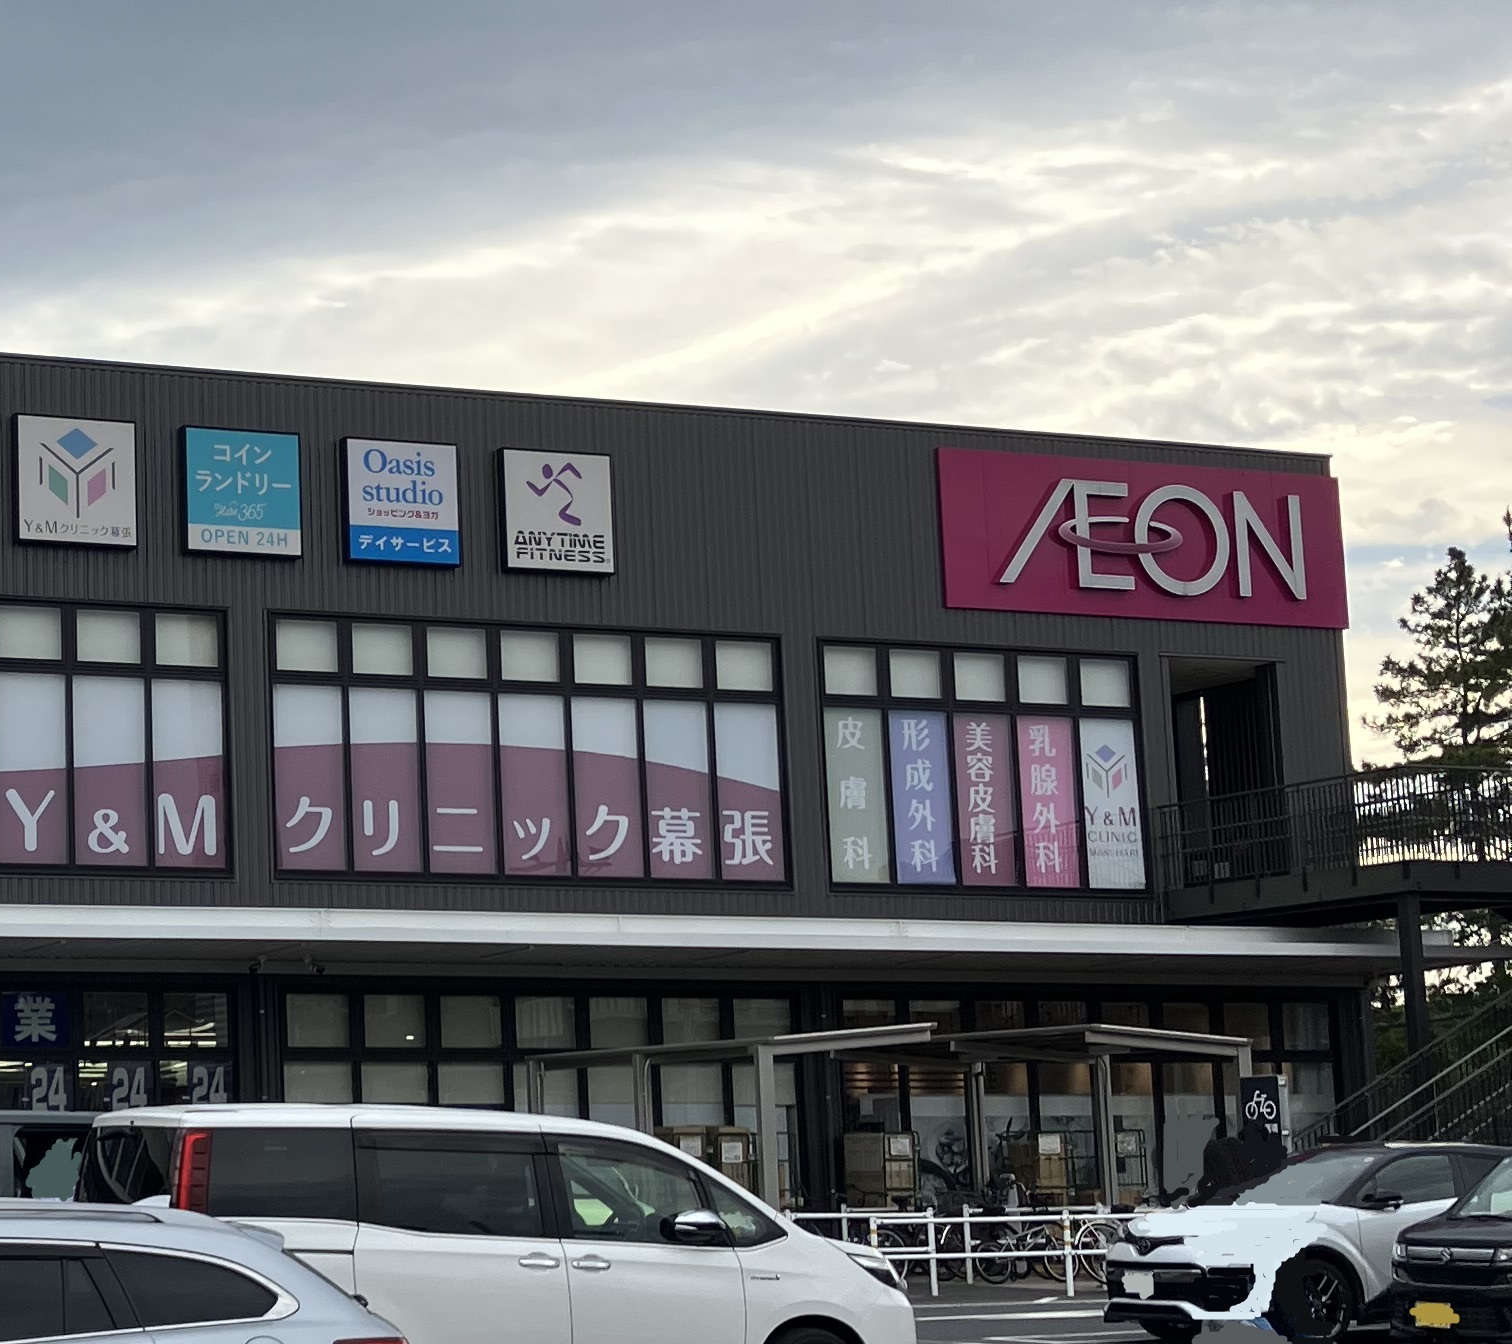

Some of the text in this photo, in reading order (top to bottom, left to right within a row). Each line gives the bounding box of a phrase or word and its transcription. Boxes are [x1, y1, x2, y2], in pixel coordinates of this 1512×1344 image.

[213, 442, 272, 466] コイン
[363, 448, 436, 477] Oasis
[194, 469, 292, 496] ランドリー
[362, 479, 444, 506] studio
[200, 528, 288, 547] OPEN 24H
[358, 534, 453, 553] デイサービス
[514, 529, 605, 550] ANYTIME
[516, 546, 606, 564] FITNESS
[836, 715, 873, 871] 皮膚科
[900, 718, 940, 874] 形成外科
[964, 720, 1000, 876] 美容皮膚科
[1027, 724, 1063, 875] 乳腺外科
[285, 794, 775, 868] クリニック幕張
[1087, 830, 1139, 845] CLINIC
